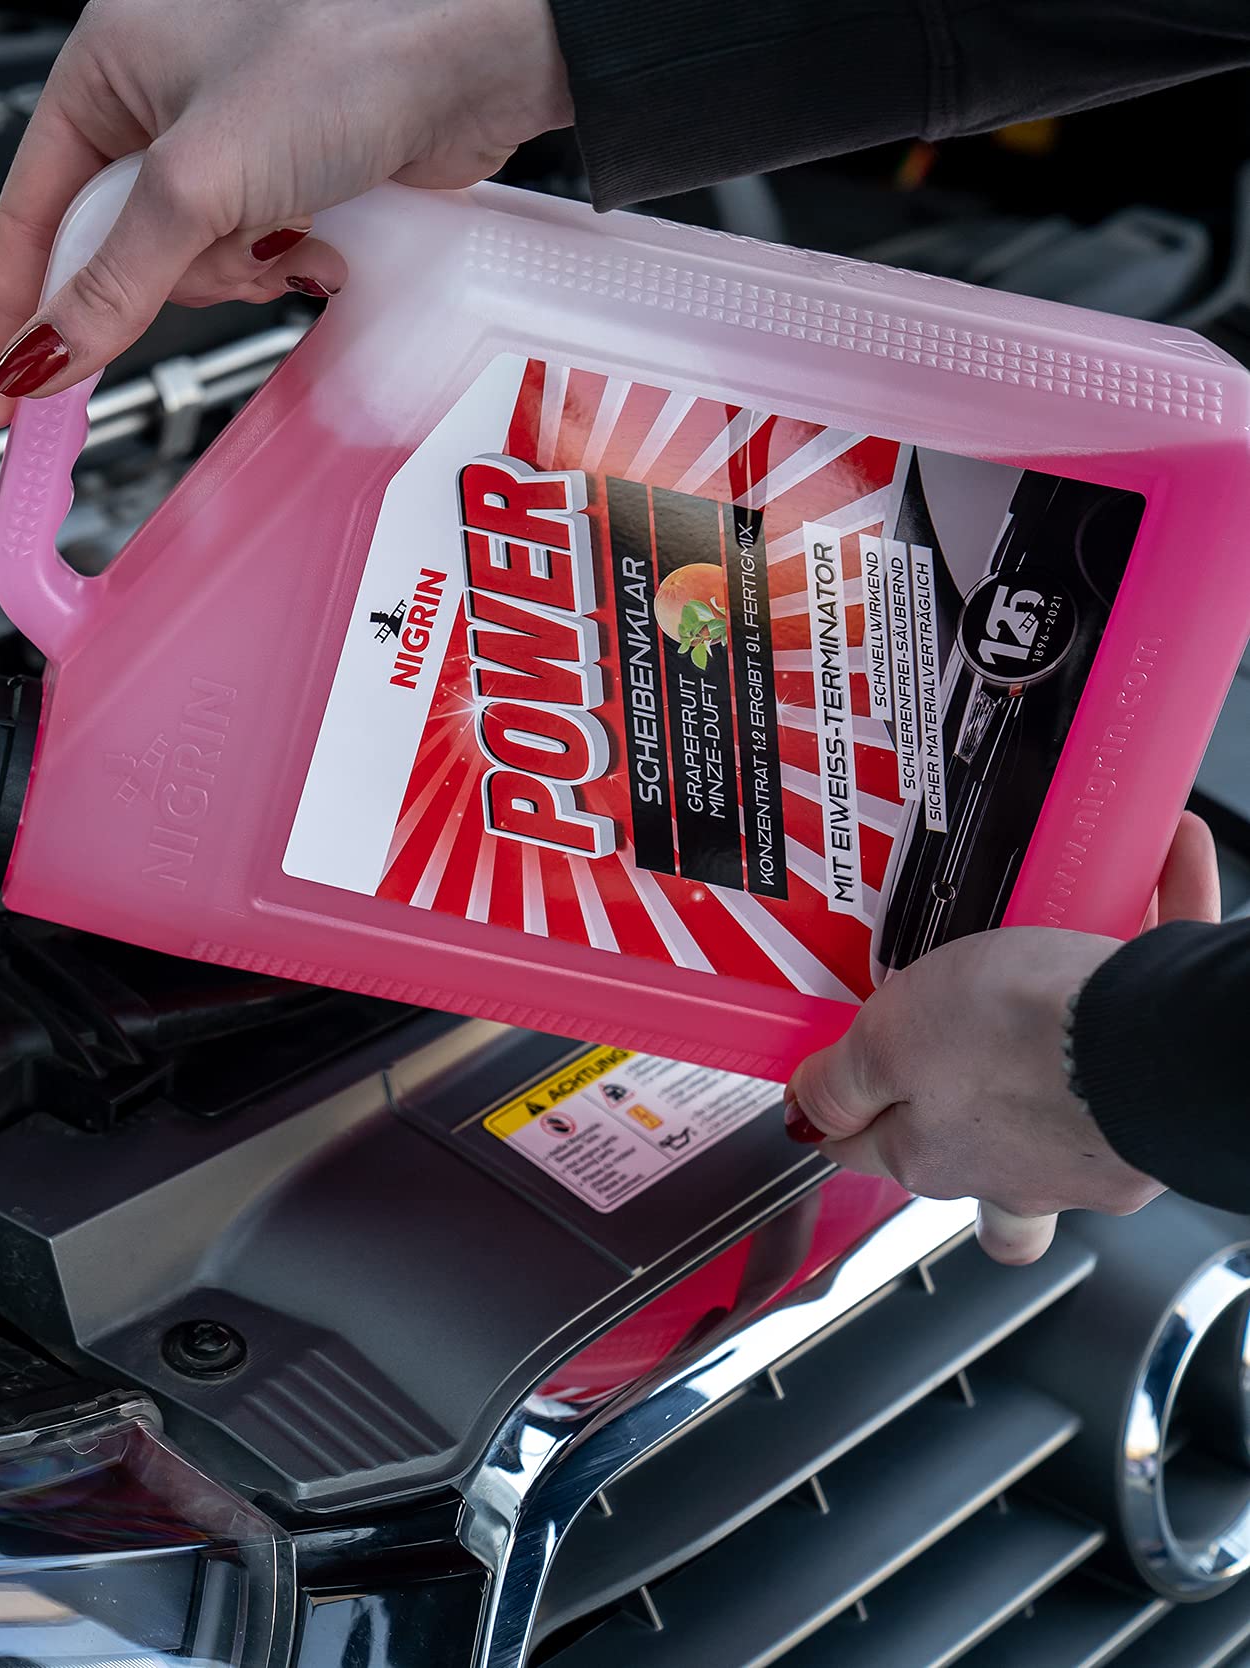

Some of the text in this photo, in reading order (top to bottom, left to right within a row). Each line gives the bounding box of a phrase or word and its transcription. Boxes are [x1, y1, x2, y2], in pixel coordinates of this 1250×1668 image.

[390, 567, 448, 690] NIGRIN
[738, 523, 759, 629] FERTIGMIX
[865, 551, 887, 708] SCHNELLWIRKEND
[978, 585, 1044, 665] 125
[1032, 595, 1063, 663] 1896-2021
[456, 453, 617, 860] POWER
[622, 556, 663, 806] SCHEIBENKLAR
[744, 655, 766, 727] ERGIBT
[813, 542, 854, 904] MIT EIWEISS-TERMINATOR
[891, 557, 916, 790] SCHLIERENFREI-SÄUBERND
[916, 562, 942, 822] SICHER MATERIALVERTRÄGLICH
[141, 676, 238, 891] NIGRIN
[678, 673, 704, 813] GRAPEFRUIT
[700, 677, 726, 819] MINZE-DUFT
[751, 730, 767, 752] 1:2
[753, 754, 775, 886] KONZENTRAT
